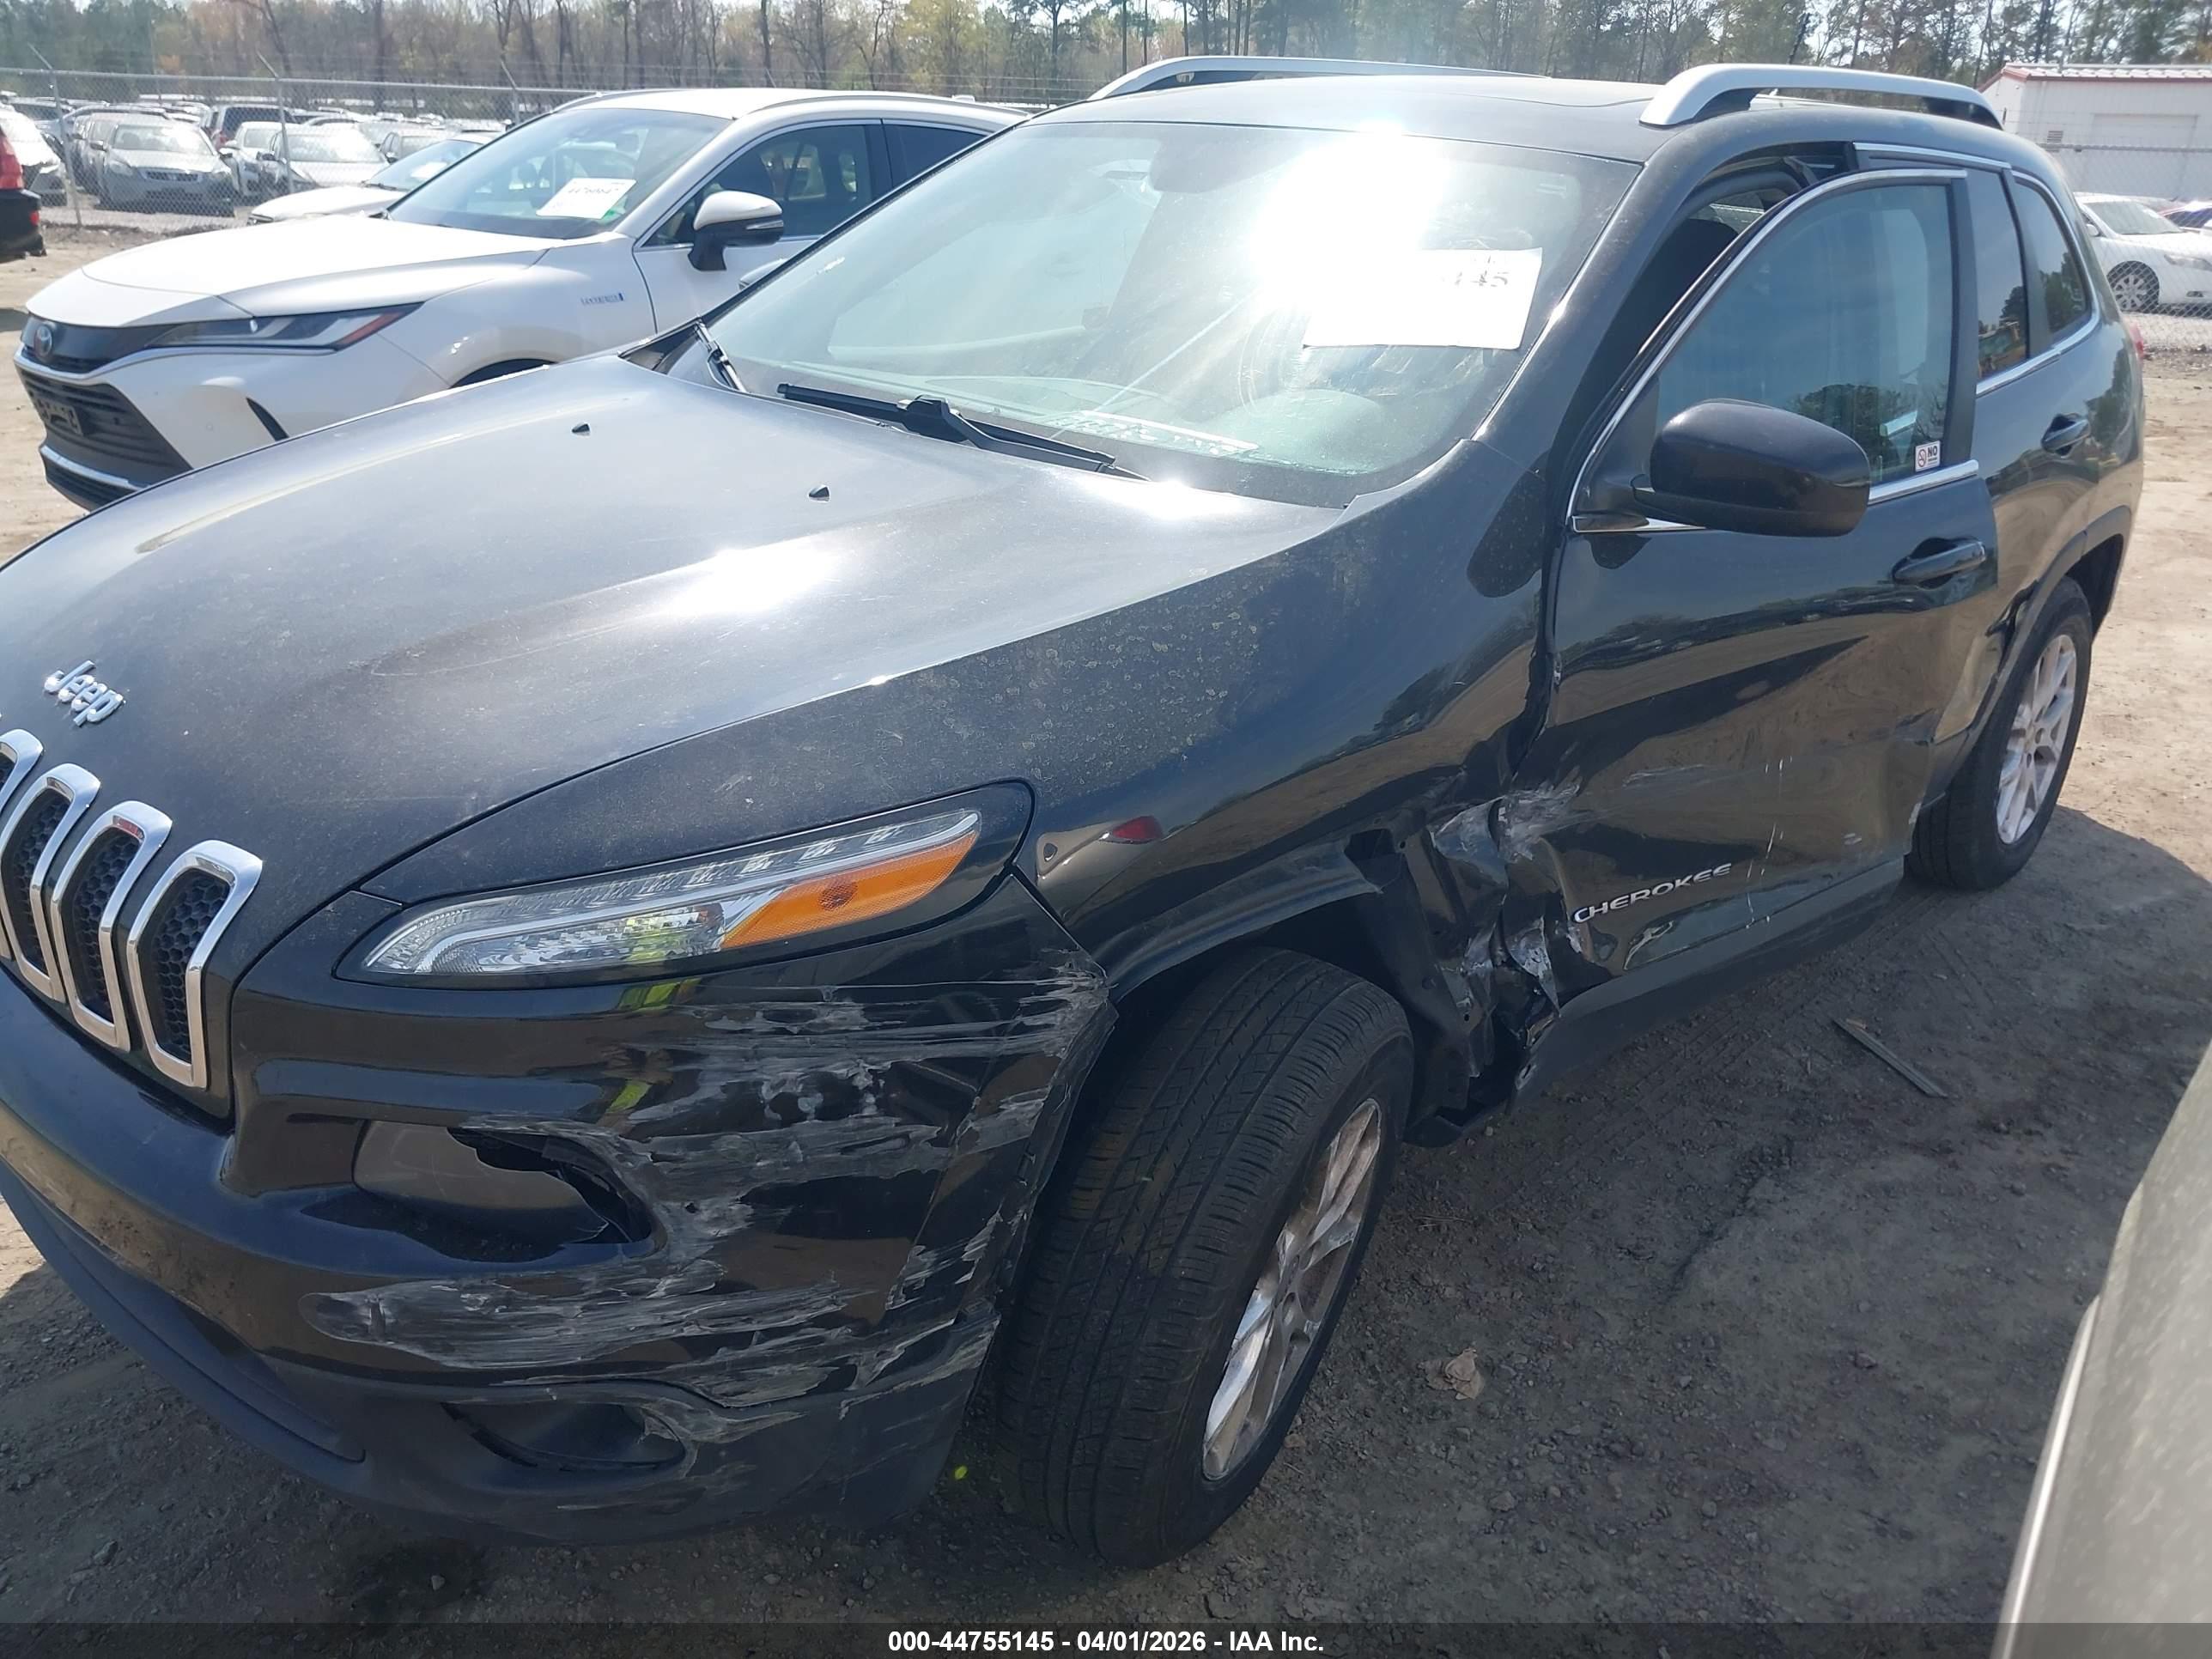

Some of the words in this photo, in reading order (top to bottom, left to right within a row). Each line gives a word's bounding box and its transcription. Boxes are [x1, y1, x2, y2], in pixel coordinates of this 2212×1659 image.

[1927, 445, 1938, 457] NO
[44, 659, 124, 727] Jeep
[1573, 862, 1732, 922] CHEROKEE
